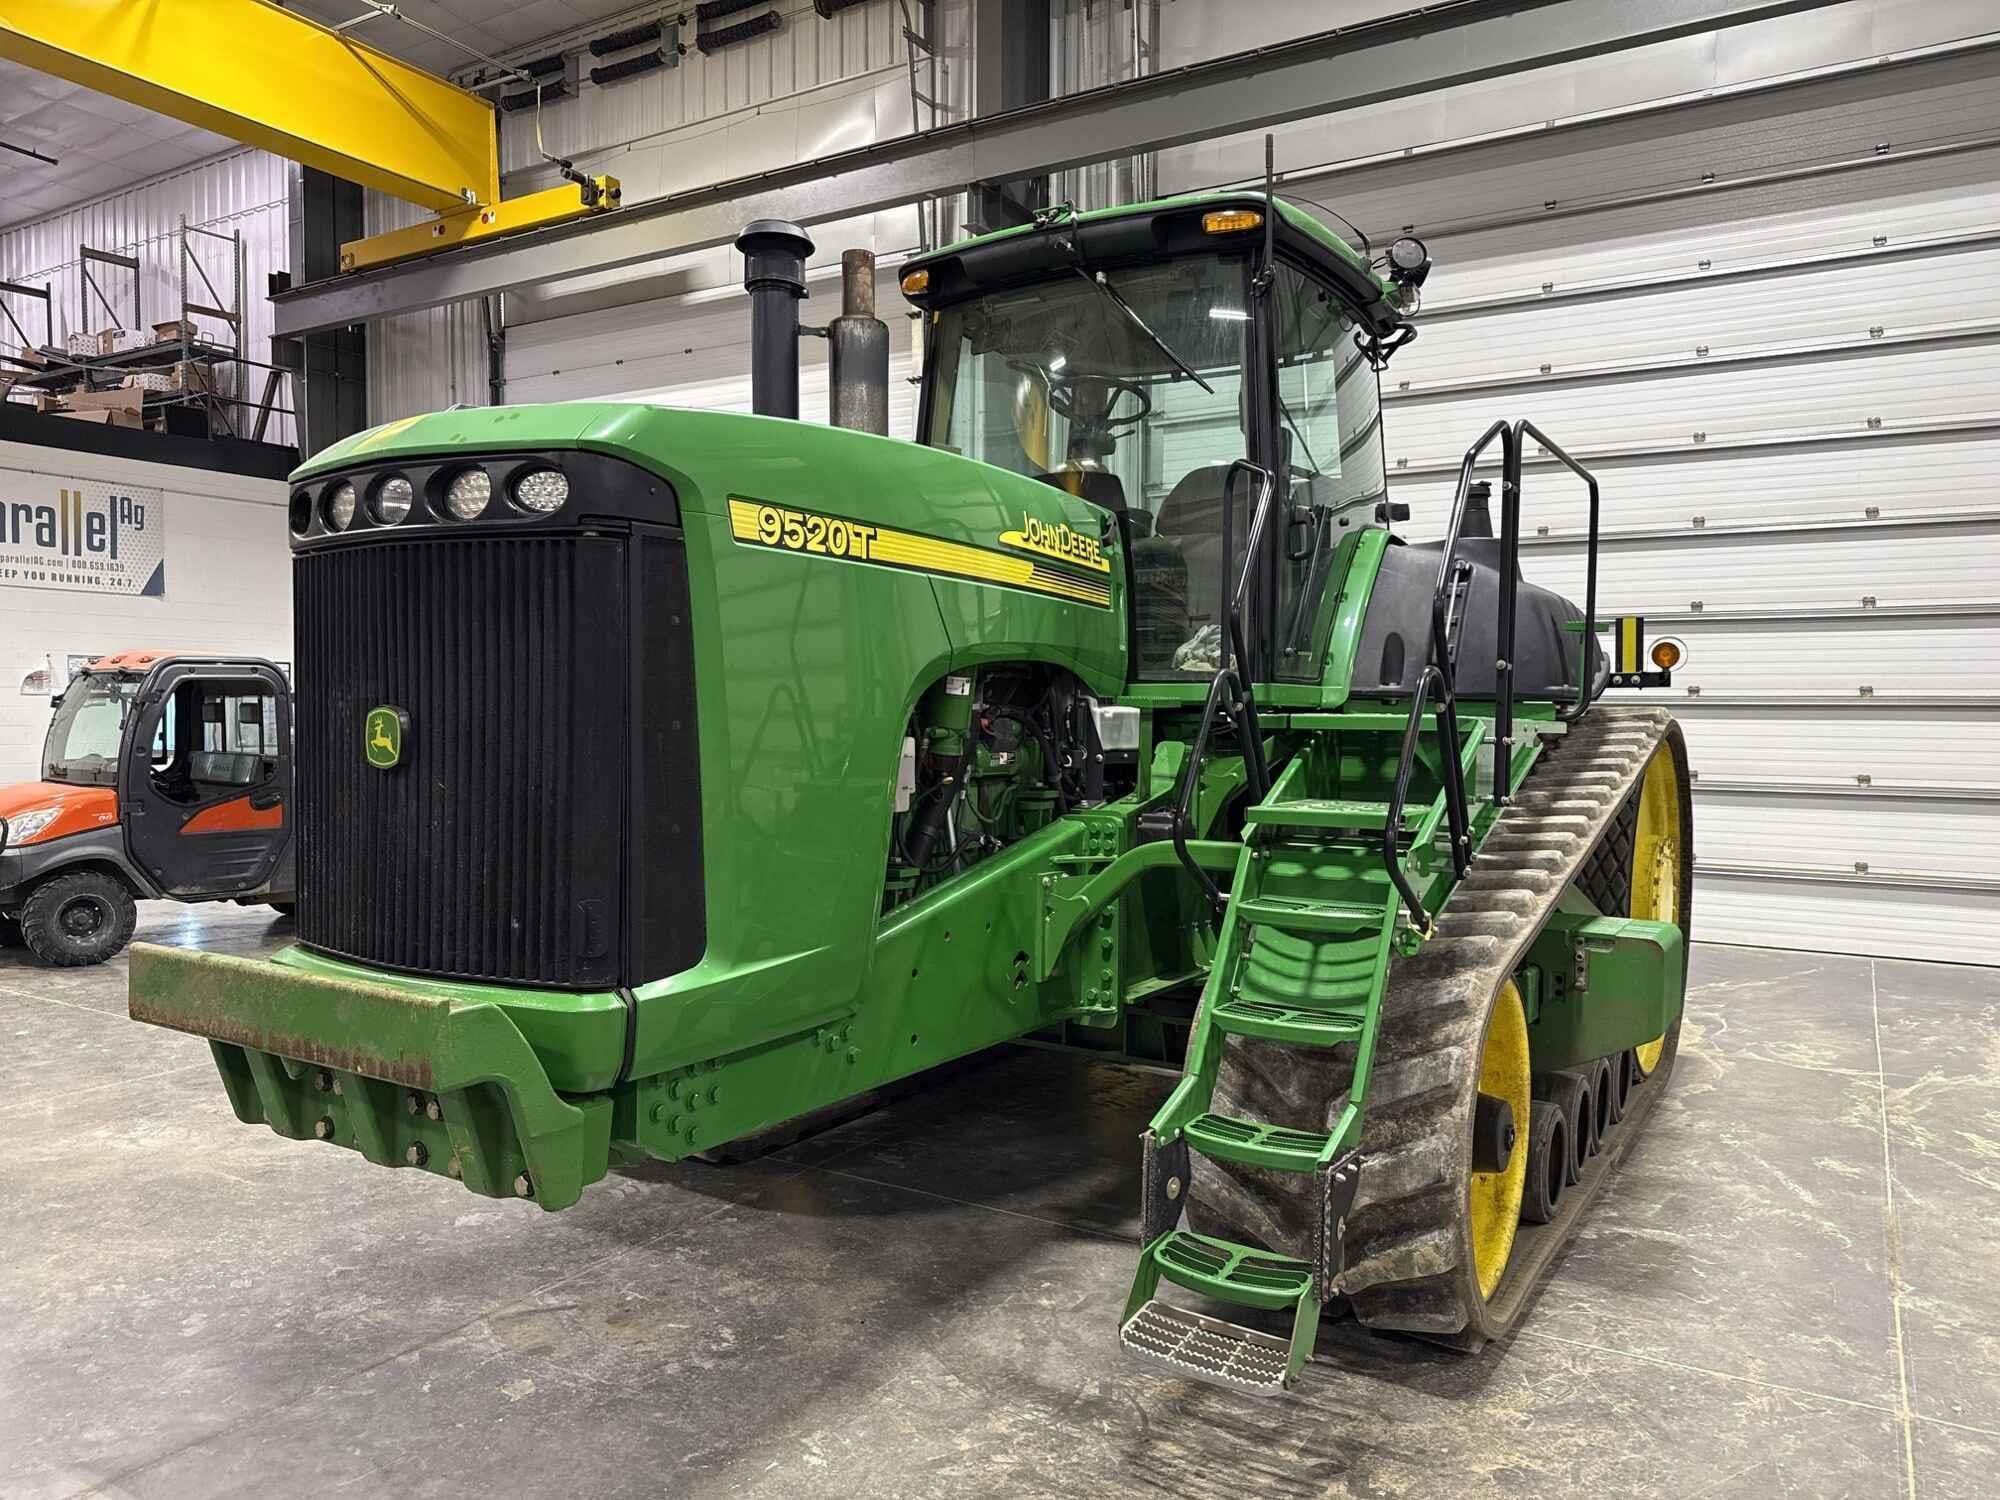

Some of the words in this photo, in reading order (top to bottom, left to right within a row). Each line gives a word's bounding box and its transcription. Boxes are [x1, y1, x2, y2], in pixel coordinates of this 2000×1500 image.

[0, 489, 117, 559] rallel
[757, 505, 877, 560] 9520T
[1021, 510, 1060, 552] JOHN
[1058, 523, 1103, 564] DEERE
[24, 570, 46, 581] YOU
